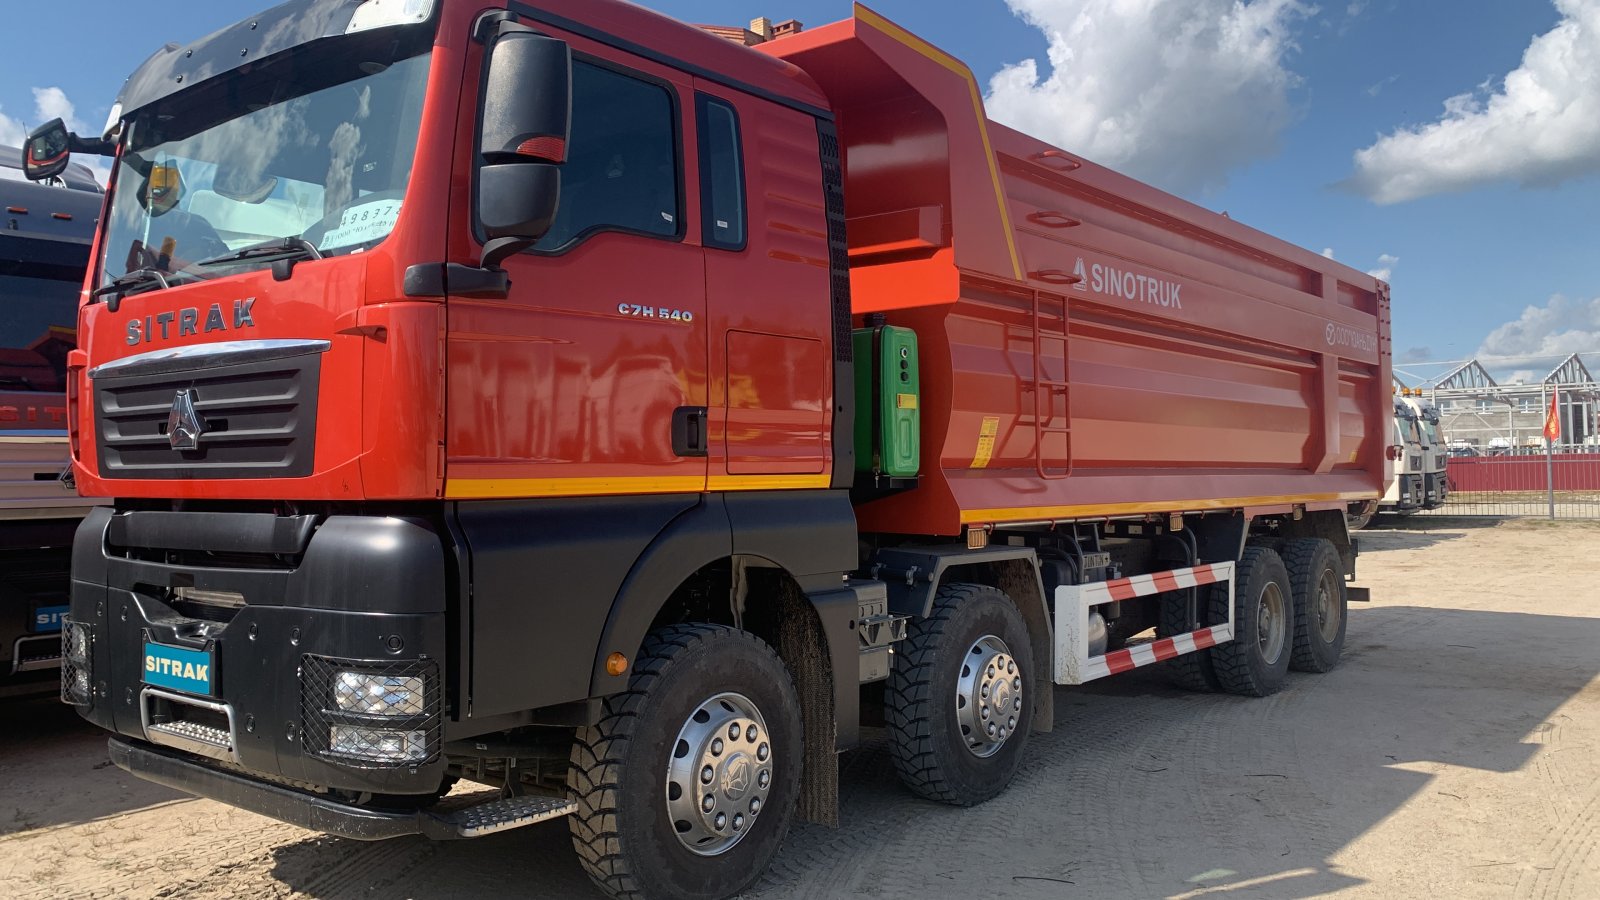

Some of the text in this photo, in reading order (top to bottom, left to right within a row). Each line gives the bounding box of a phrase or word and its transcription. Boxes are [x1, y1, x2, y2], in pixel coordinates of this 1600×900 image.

[1091, 263, 1182, 309] SINOTRUK
[126, 297, 256, 346] SITRAK
[618, 303, 693, 322] C7H 540
[145, 655, 209, 682] SITRAK
